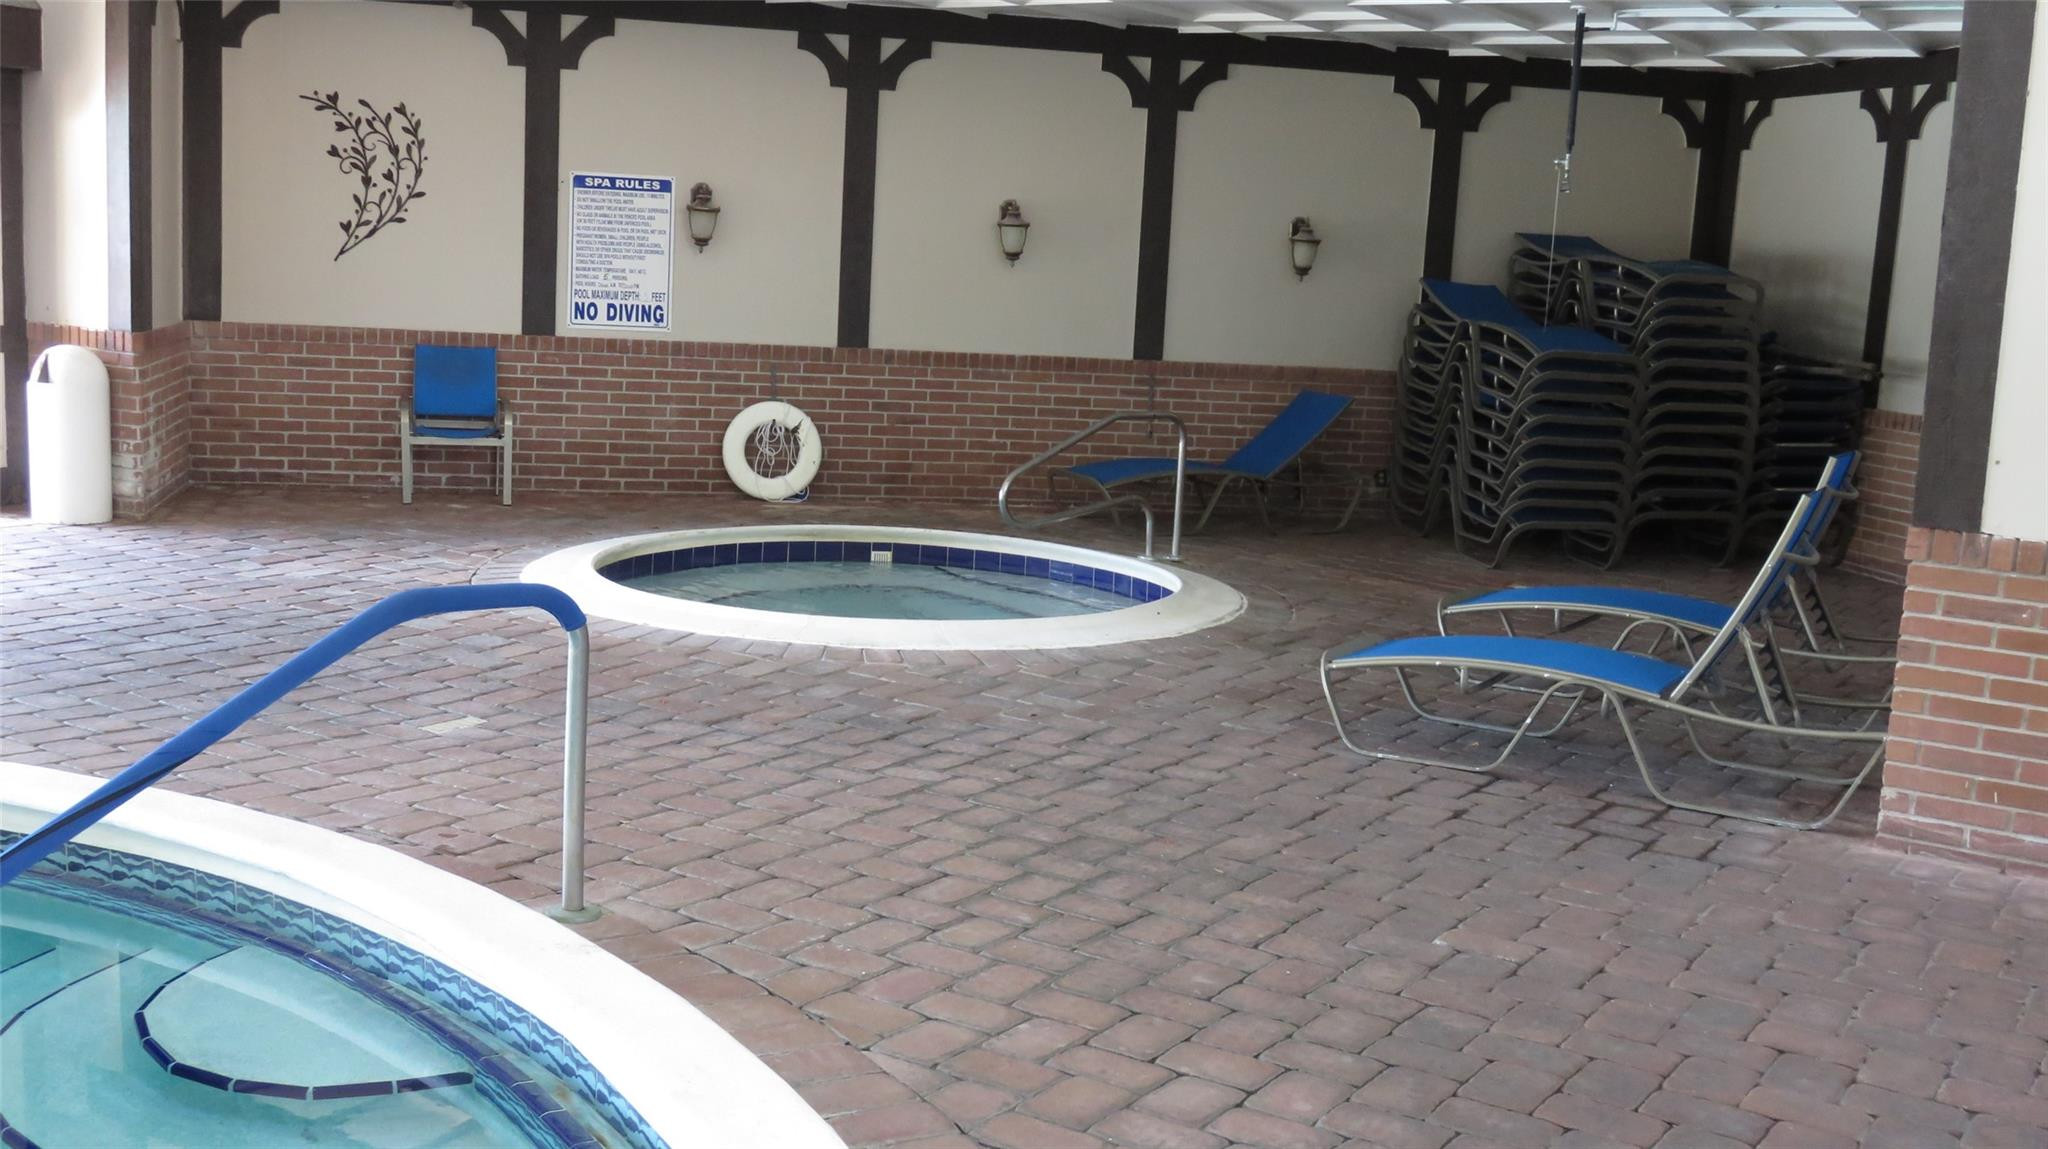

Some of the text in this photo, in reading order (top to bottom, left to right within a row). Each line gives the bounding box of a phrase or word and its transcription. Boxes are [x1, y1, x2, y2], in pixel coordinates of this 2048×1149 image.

[585, 177, 661, 190] SPA RULES
[574, 289, 666, 302] POOL MAXIMUM DEPTH FEET
[574, 301, 664, 323] NO DIVING
